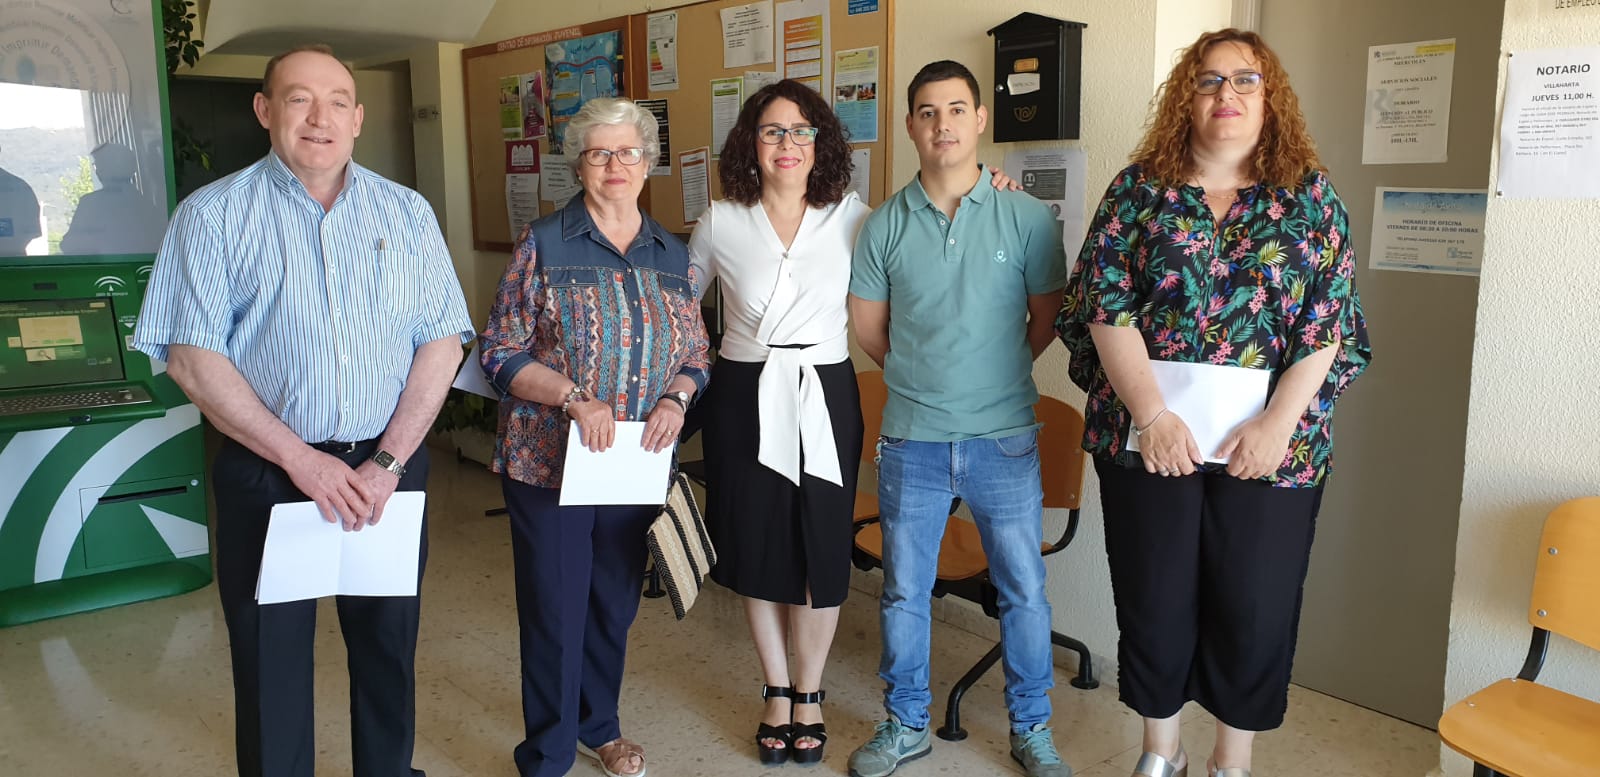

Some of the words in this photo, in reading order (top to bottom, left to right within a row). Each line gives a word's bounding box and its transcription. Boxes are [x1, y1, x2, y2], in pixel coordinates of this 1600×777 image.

[497, 40, 516, 52] CENTRO
[554, 27, 582, 40] JUVENIL
[1536, 63, 1591, 76] NOTARIO
[1543, 81, 1580, 89] VILLAHARTA
[1531, 93, 1560, 102] JUEVES
[1563, 92, 1584, 101] 11,00
